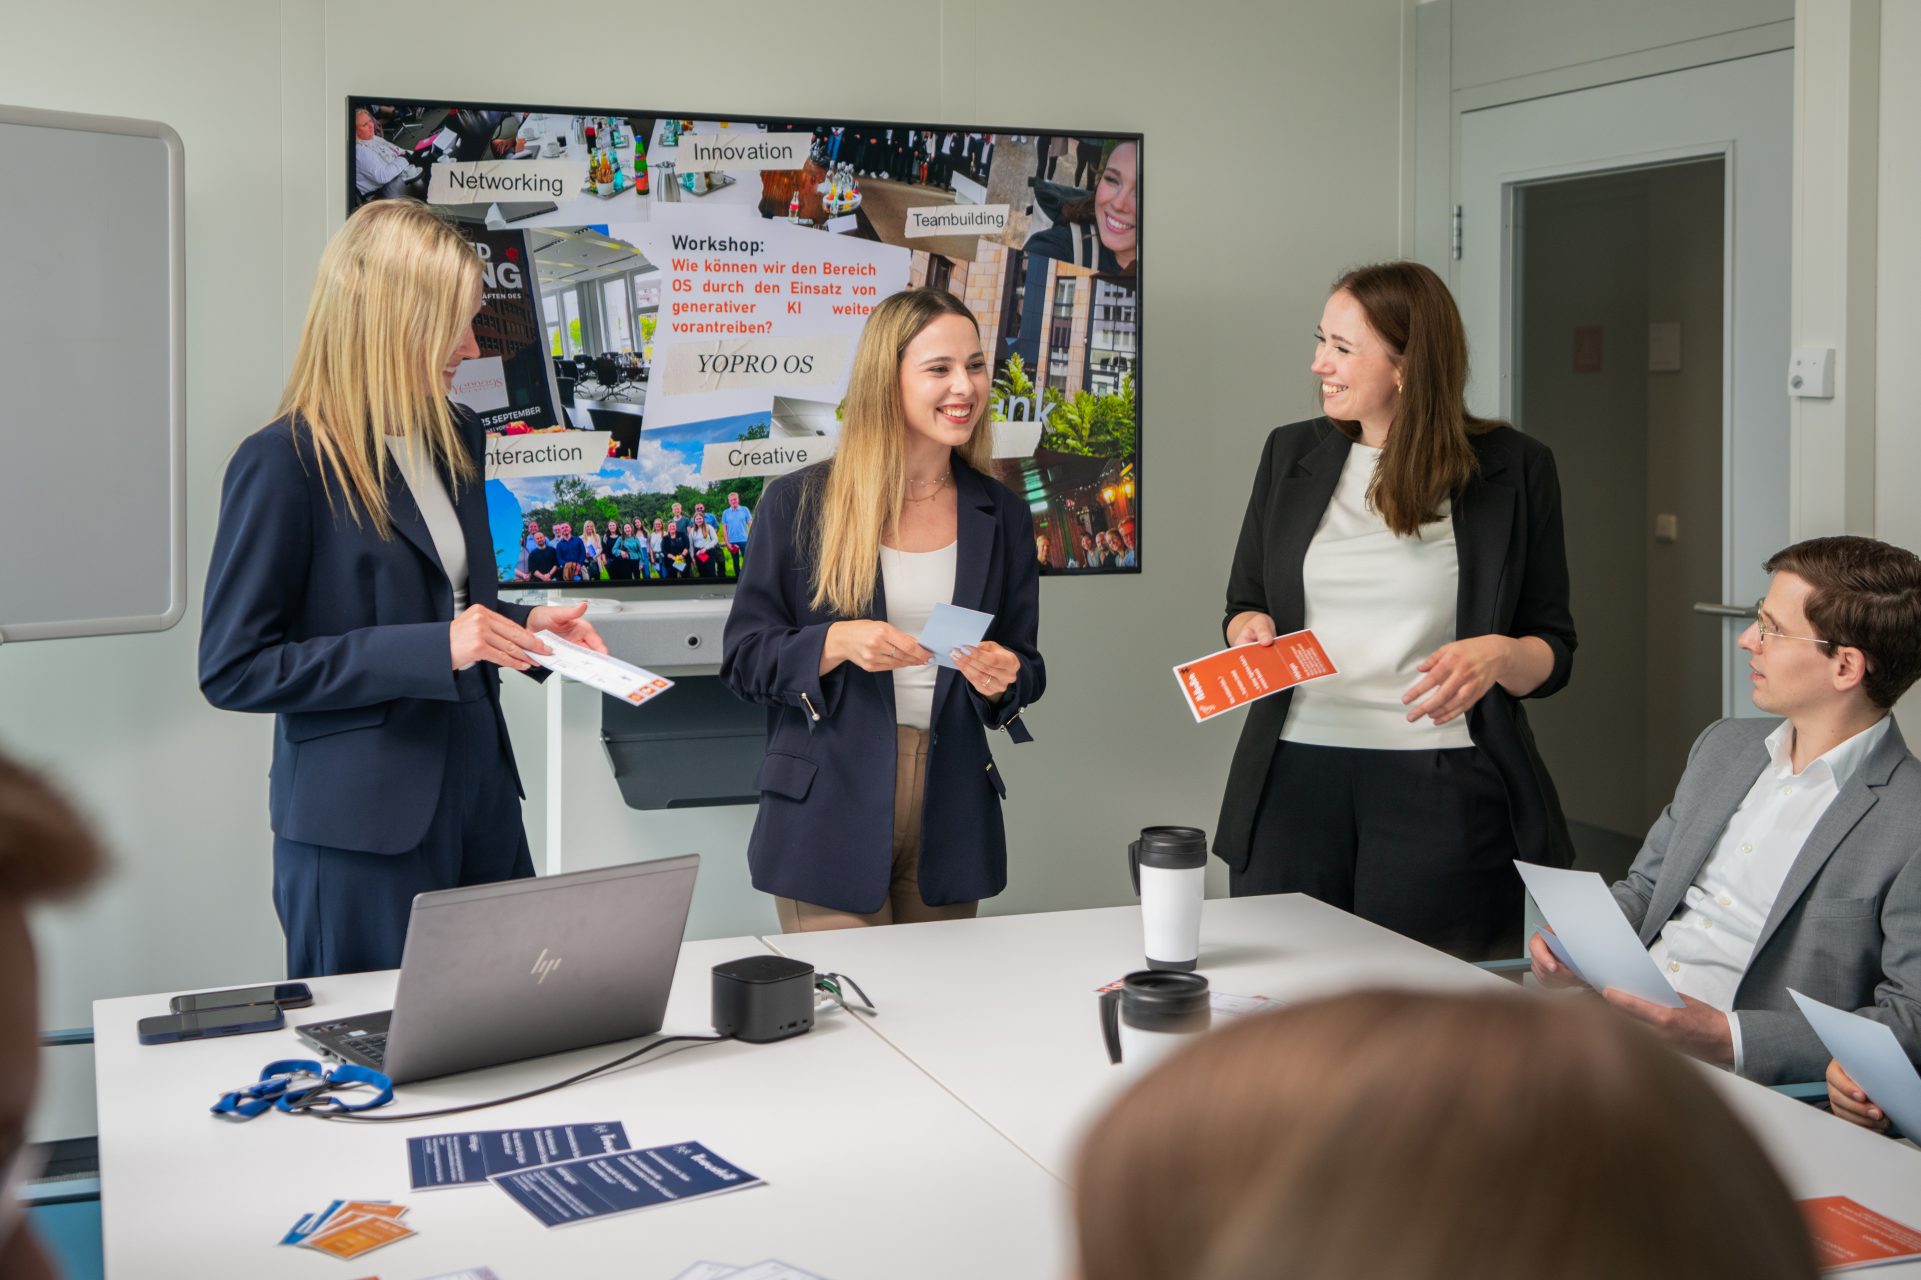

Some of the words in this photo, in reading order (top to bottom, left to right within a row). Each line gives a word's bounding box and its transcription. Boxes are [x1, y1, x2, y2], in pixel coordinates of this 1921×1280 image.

[694, 142, 793, 161] Innovation
[449, 171, 563, 197] Networking
[912, 211, 1004, 229] Teambuilding
[672, 235, 764, 256] Workshop:
[672, 258, 698, 272] Wie
[704, 259, 757, 273] können
[763, 261, 786, 274] wir
[791, 261, 817, 275] den
[823, 262, 877, 276] Bereich
[672, 279, 692, 293] OS
[703, 280, 744, 294] durch
[754, 281, 780, 294] den
[790, 281, 842, 295] Einsatz
[852, 285, 877, 296] von
[672, 301, 757, 315] generativer
[787, 301, 801, 314] KI
[832, 302, 877, 315] weiter
[672, 321, 773, 334] vorantreiben?
[698, 354, 777, 373] YOPRO
[783, 354, 814, 374] OS
[492, 406, 542, 424] SEPTEMBER
[485, 444, 582, 465] nteraction
[728, 446, 808, 467] Creative
